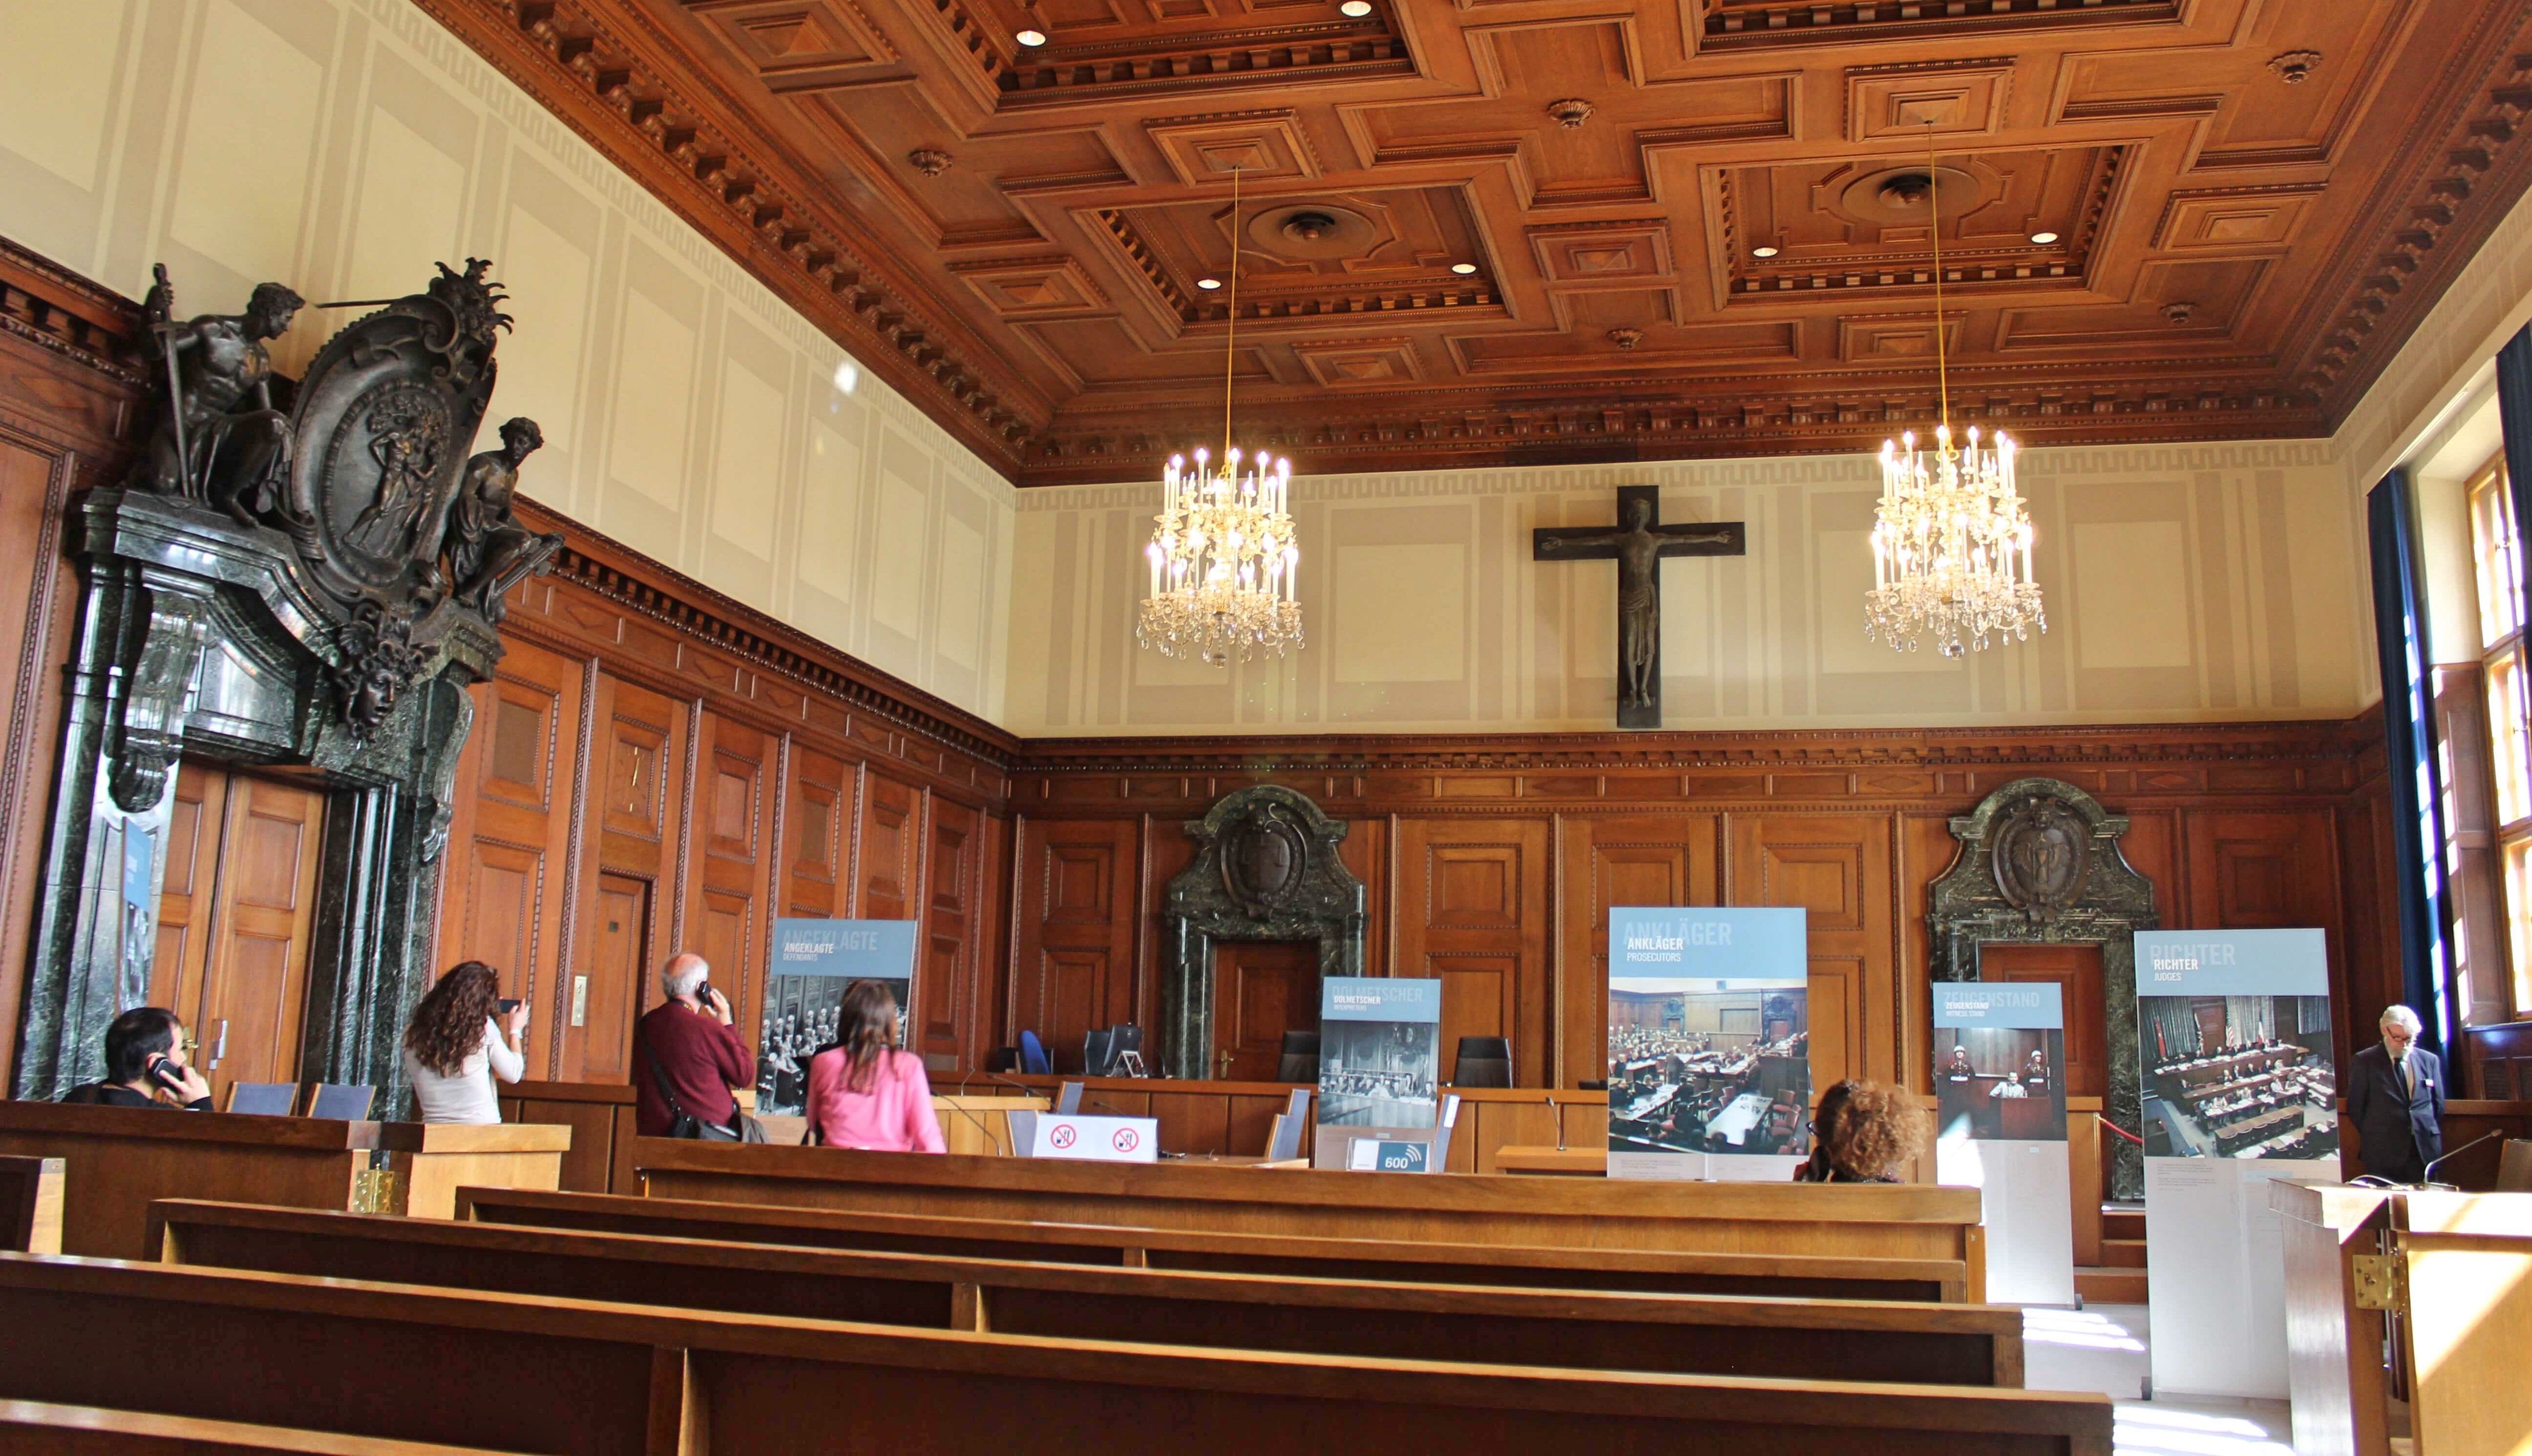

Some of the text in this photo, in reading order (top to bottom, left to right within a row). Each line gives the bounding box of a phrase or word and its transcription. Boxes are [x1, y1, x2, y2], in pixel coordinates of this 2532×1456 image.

[784, 943, 833, 953] ANGEKLAGTE
[1627, 936, 1683, 950] ANKLÄGER
[1627, 952, 1681, 962] PROSECUTORS
[2150, 944, 2236, 965] RICHTER
[2154, 959, 2198, 970] RICHTER
[2153, 972, 2181, 981] JUDGES
[1333, 995, 1381, 1004] DOLMETSCHER
[1385, 1157, 1408, 1169] 600
